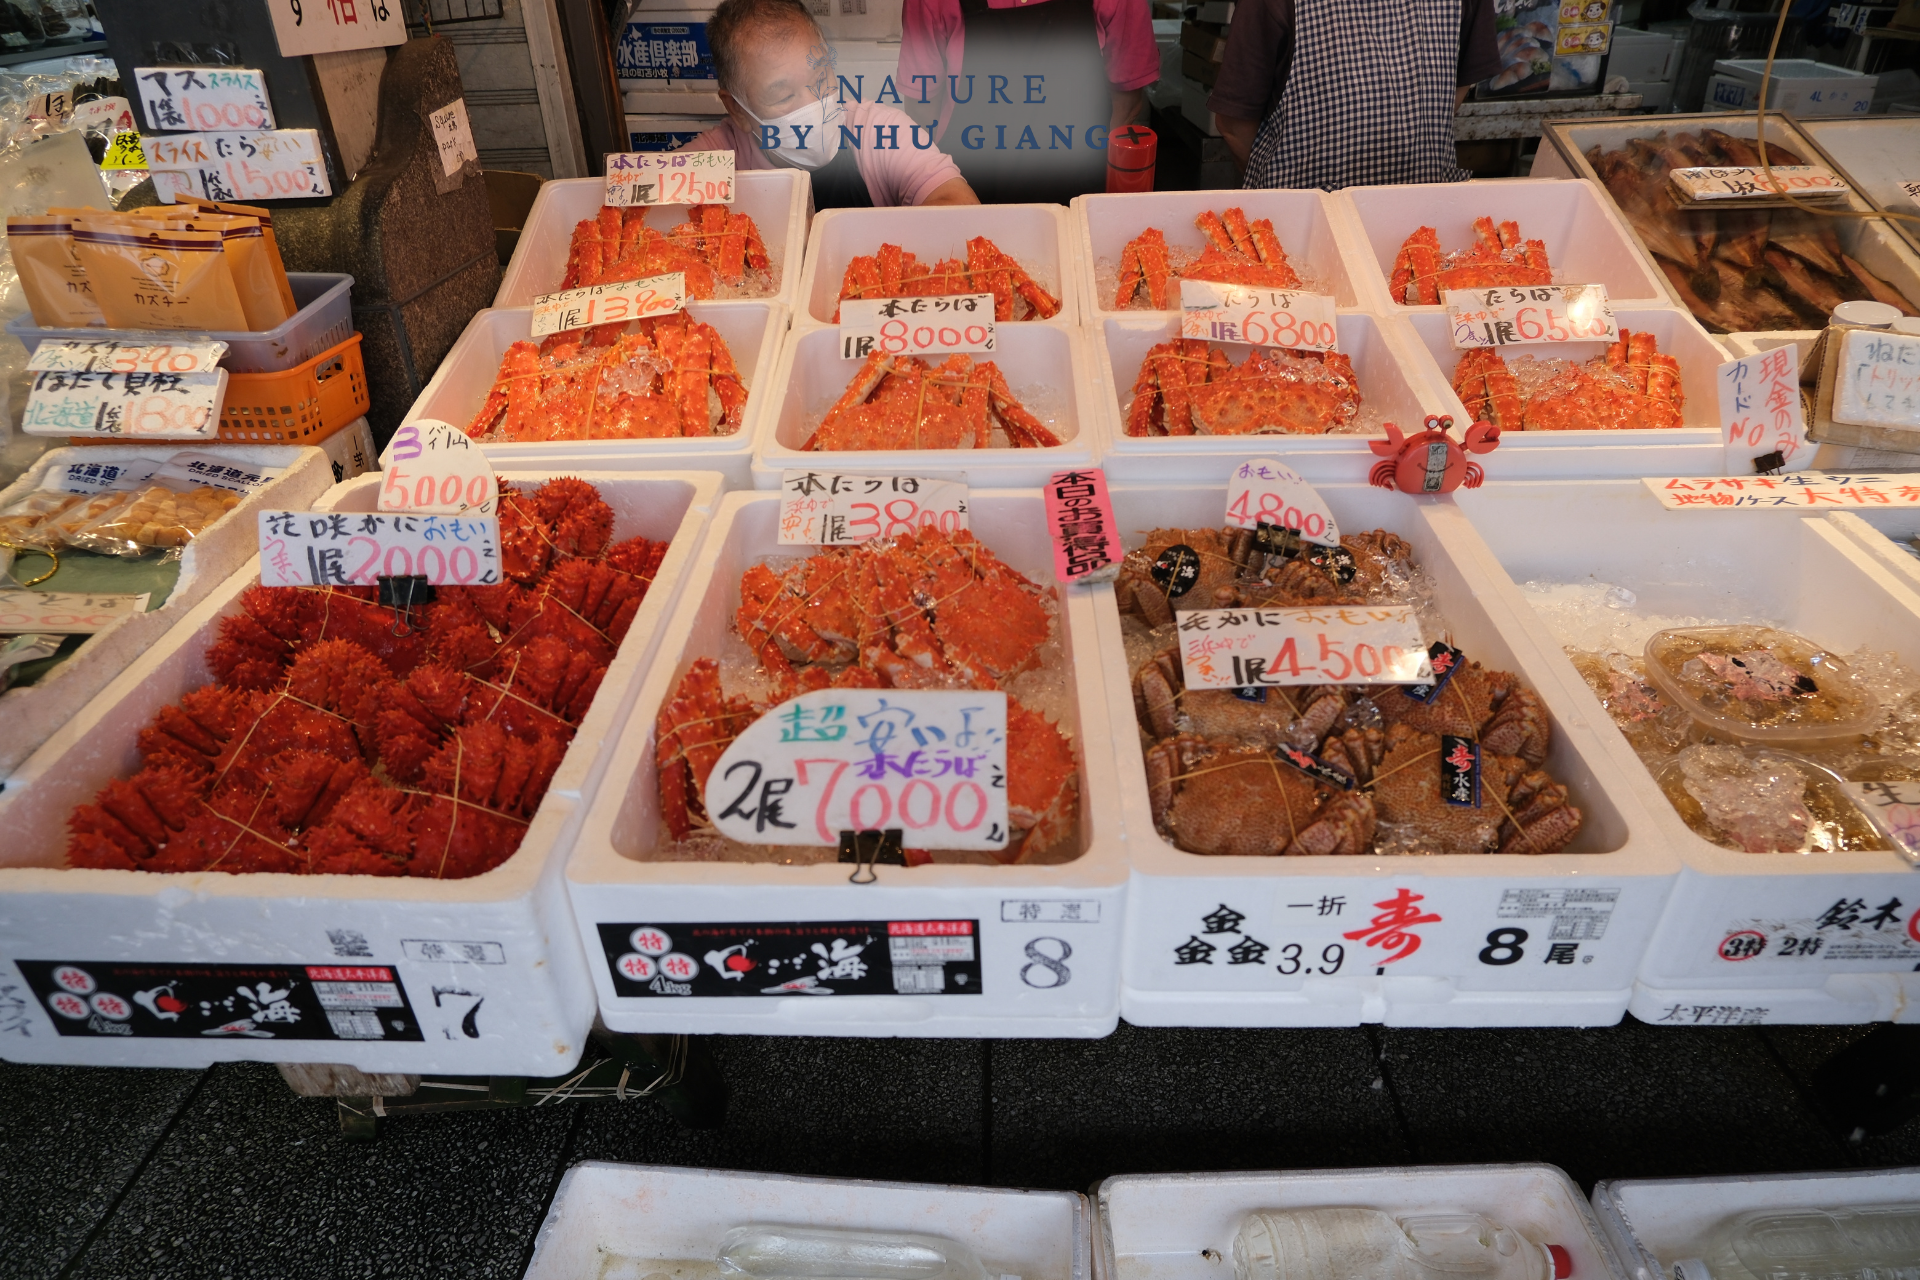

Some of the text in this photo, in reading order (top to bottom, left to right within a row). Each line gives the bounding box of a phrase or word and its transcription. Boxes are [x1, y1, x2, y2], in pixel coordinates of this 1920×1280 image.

[141, 71, 259, 97] マス スライス
[1853, 101, 1869, 112] 20
[151, 140, 209, 164] スライス
[215, 135, 256, 158] たら
[1726, 361, 1752, 414] カード
[1758, 348, 1800, 461] 現金のみ
[1728, 417, 1765, 447] NO
[67, 463, 128, 481] 北海道
[68, 474, 96, 485] DRIED
[188, 468, 218, 478] DRIED
[1664, 477, 1784, 491] ムラサキ
[265, 513, 419, 540] 花咲かに
[1052, 471, 1112, 576] 本日のお買得品
[347, 536, 479, 586] 2000
[1180, 611, 1280, 632] 毛かに
[718, 760, 797, 833] 2尾
[793, 758, 988, 843] 7000
[1286, 894, 1348, 917] 一折
[1815, 896, 1903, 931] 鈴木
[1201, 903, 1246, 935] 金
[638, 931, 664, 951] 特
[1478, 926, 1529, 966] 8
[1543, 942, 1580, 965] 尾
[1777, 936, 1826, 957] 2特
[624, 956, 691, 977] 特 特
[1019, 936, 1073, 989] 8
[1276, 942, 1346, 976] 3.9
[431, 984, 485, 1039] 7
